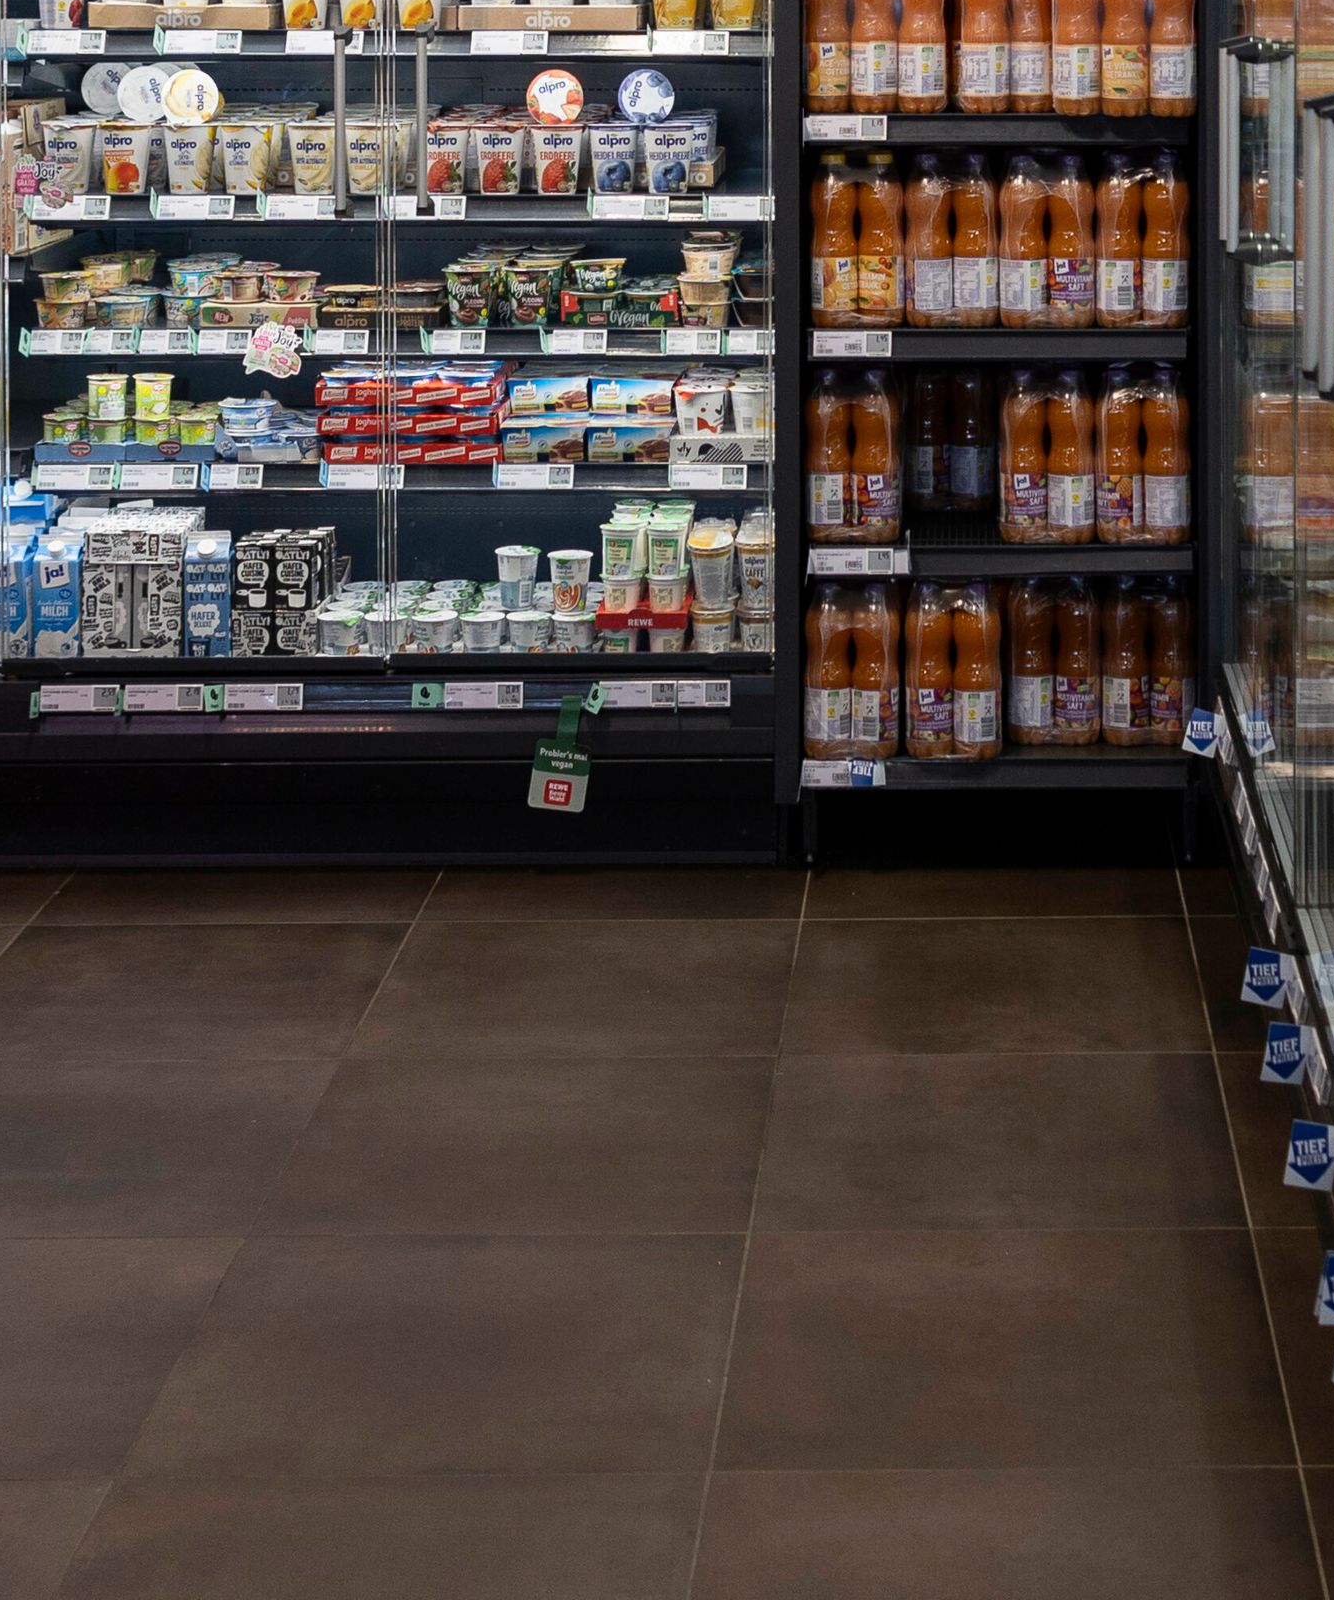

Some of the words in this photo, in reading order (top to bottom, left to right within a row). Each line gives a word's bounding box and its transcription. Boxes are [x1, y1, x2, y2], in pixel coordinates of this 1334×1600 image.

[525, 13, 571, 29] alpro
[538, 80, 566, 95] alpro
[48, 139, 77, 153] alpro
[104, 135, 132, 149] alpro
[171, 139, 197, 151] alpro
[226, 139, 251, 151] alpro
[482, 134, 512, 148] alpro
[543, 134, 573, 148] alpro
[598, 134, 630, 148] alpro
[655, 134, 686, 148] alpro
[480, 151, 515, 161] ERDBEERE
[540, 151, 575, 160] ERDBEERE
[448, 280, 480, 298] Vegan
[510, 278, 538, 298] Vegan
[1068, 283, 1086, 291] SAFT
[334, 317, 367, 328] alpro
[677, 442, 691, 456] vly
[236, 551, 270, 560] OATLY!
[275, 551, 310, 559] OATLY!
[45, 566, 64, 580] ja!
[41, 605, 68, 617] MILCH
[191, 612, 216, 620] HAFER
[627, 617, 654, 627] REWE
[1067, 701, 1085, 710] SAFT
[934, 712, 953, 721] SAFT
[1192, 720, 1213, 731] TIEF
[540, 748, 573, 759] Probier's
[551, 760, 573, 769] vegan
[549, 783, 568, 791] REWE
[1250, 964, 1278, 977] TIEF
[1271, 1038, 1299, 1053] TIEF
[1294, 1138, 1326, 1154] TIEF
